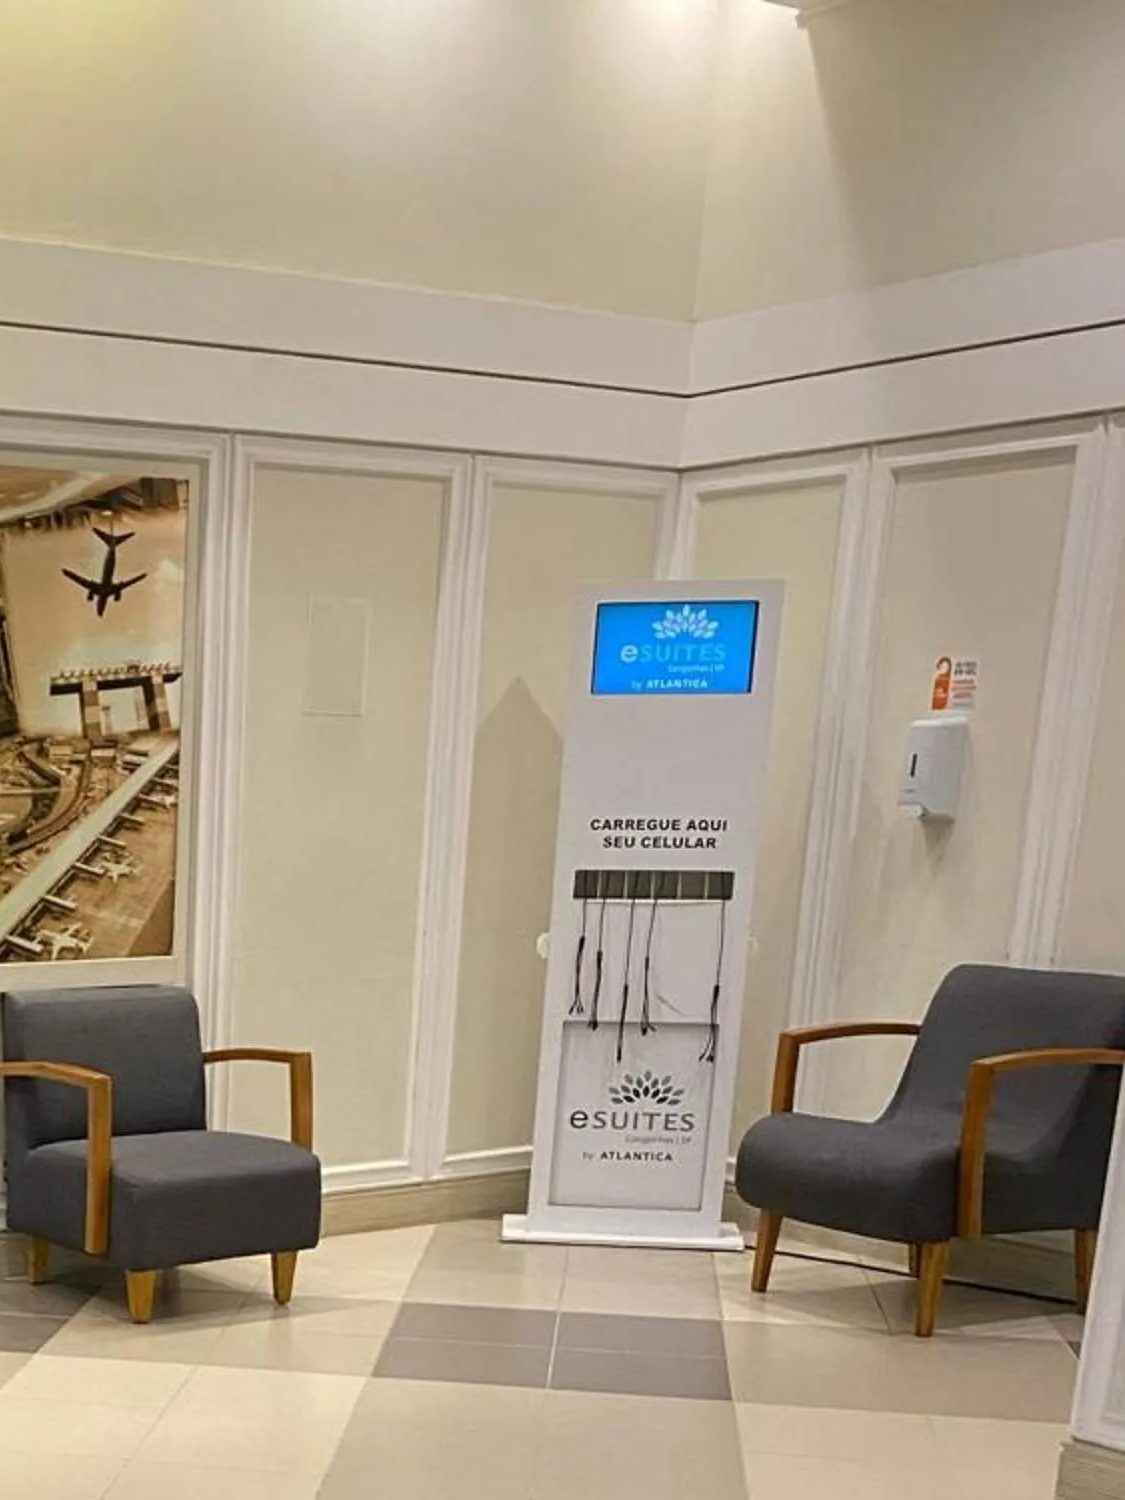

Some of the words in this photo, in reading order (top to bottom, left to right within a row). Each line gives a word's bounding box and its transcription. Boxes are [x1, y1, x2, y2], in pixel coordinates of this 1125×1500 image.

[620, 643, 727, 663] eSUITES
[646, 679, 708, 689] ATLANTICA
[590, 818, 681, 831] CARREGUE
[686, 819, 728, 832] AQUI
[603, 836, 636, 849] SEU
[640, 837, 717, 849] CELULAR
[570, 1109, 696, 1132] eSUITES
[600, 1151, 673, 1162] ATLANTICA
